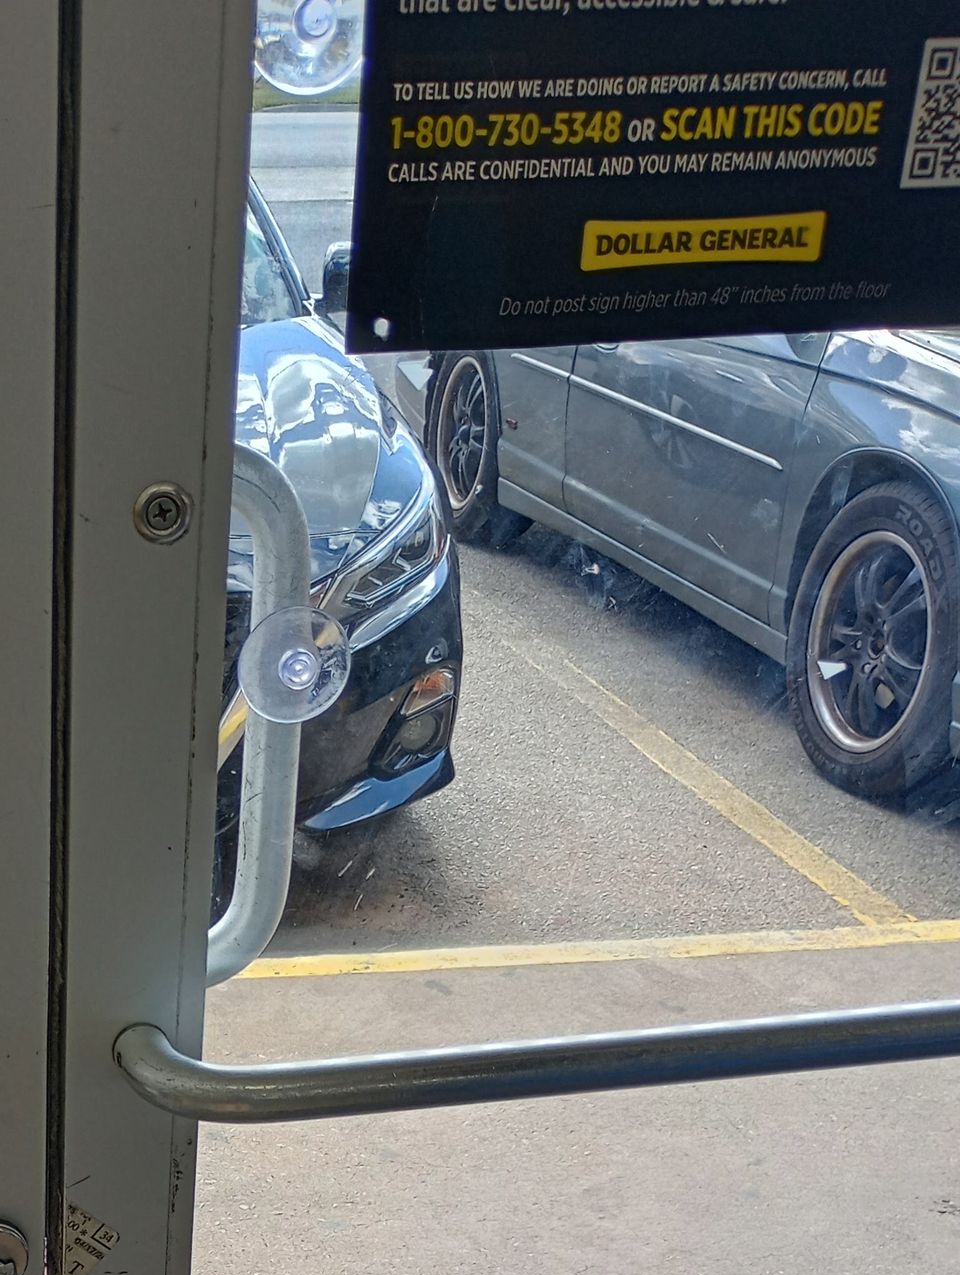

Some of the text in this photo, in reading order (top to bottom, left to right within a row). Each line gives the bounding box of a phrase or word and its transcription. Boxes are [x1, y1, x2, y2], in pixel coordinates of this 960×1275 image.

[393, 68, 887, 101] TO TELL US HOW WE ARE DOING OR REPORT A SAFETY CONCERN, CALL
[391, 101, 883, 149] 1-800-730-5348 OR SCAN THIS CODE
[389, 147, 877, 182] CALLS ARE CONFIDENTIAL AND YOU MAY REMAIN ANONYMOUS
[595, 227, 809, 256] DOLLAR GENERAL
[499, 297, 521, 316] Do
[524, 296, 550, 314] not
[552, 294, 586, 317] post
[588, 292, 619, 314] sign
[623, 288, 671, 312] higher
[673, 287, 707, 308] than
[740, 285, 788, 304] inches
[790, 283, 826, 301] from
[828, 282, 854, 300] the
[856, 280, 890, 298] floor
